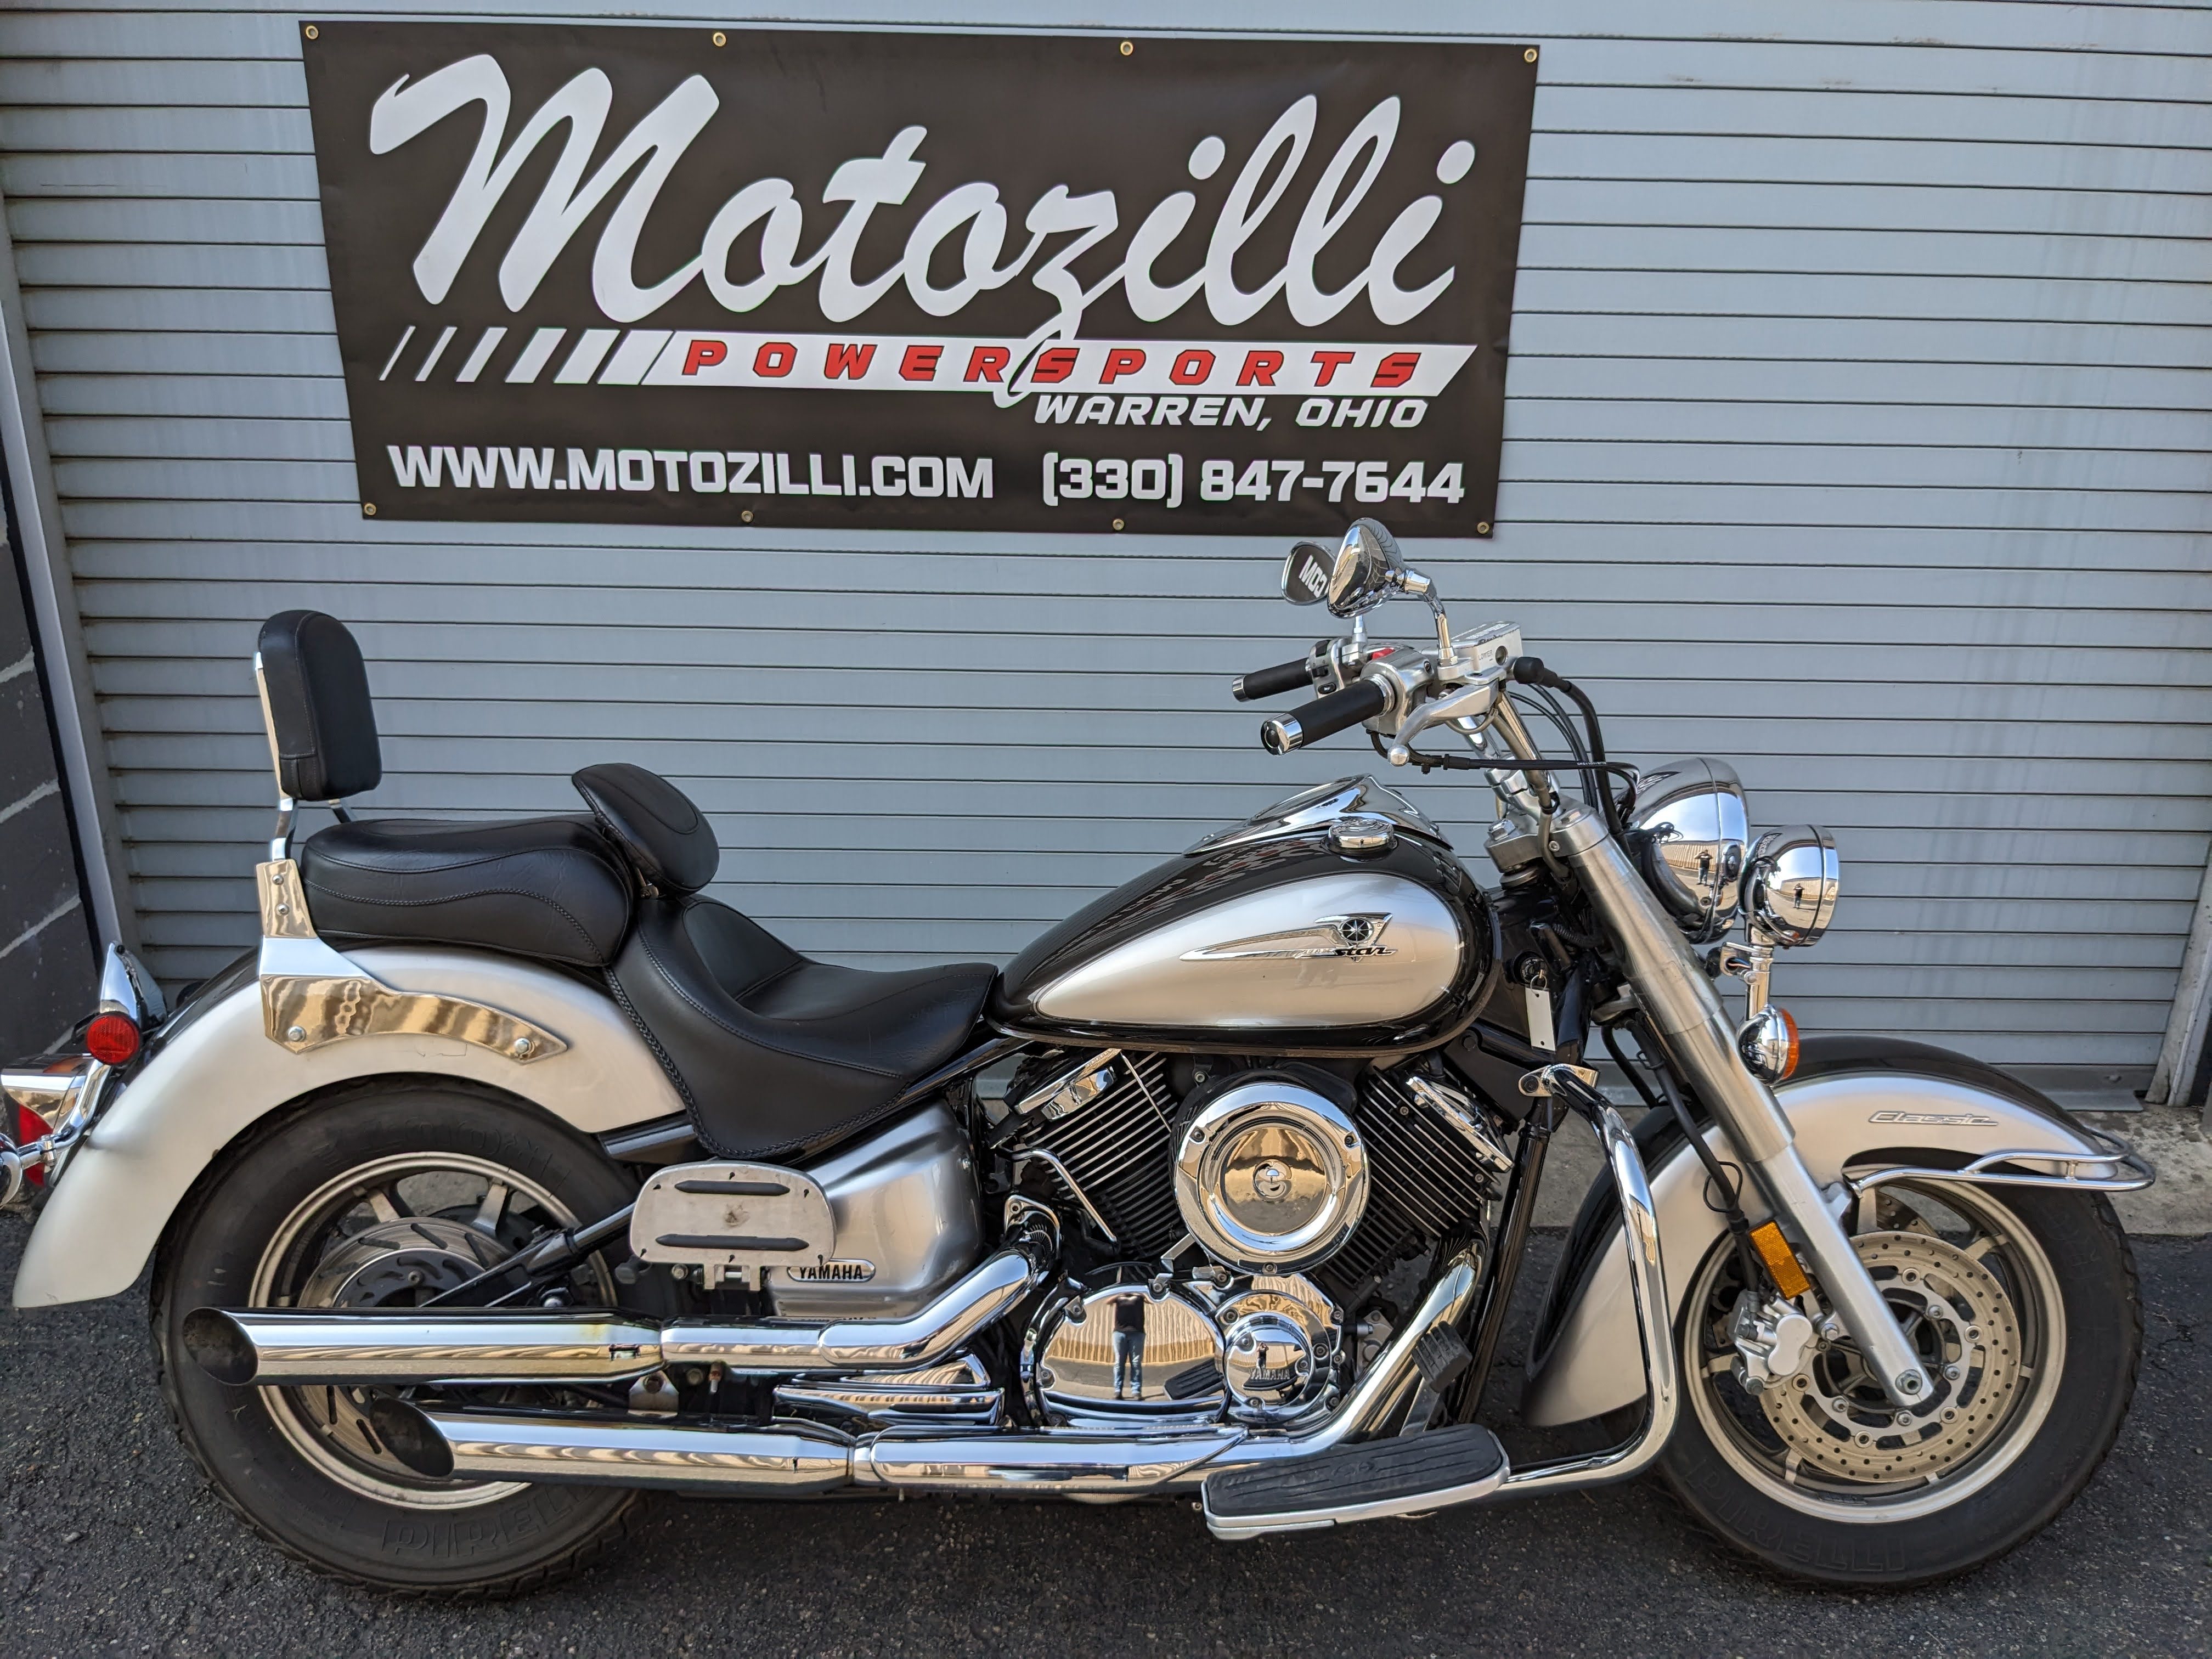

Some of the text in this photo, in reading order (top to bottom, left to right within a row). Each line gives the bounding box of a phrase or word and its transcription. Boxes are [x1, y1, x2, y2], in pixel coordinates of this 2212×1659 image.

[370, 53, 1476, 408] Motozilli
[683, 339, 1420, 388] POWERSPORTS
[1035, 395, 1428, 431] WARREN, OHIO
[387, 445, 1465, 508] WWW.MOTOZILLI.COM (330) 847-7644
[1868, 1110, 1999, 1126] Classic
[799, 1264, 864, 1280] YAMAHA
[1248, 1368, 1290, 1380] YAMAHA
[381, 1484, 597, 1558] PIREL
